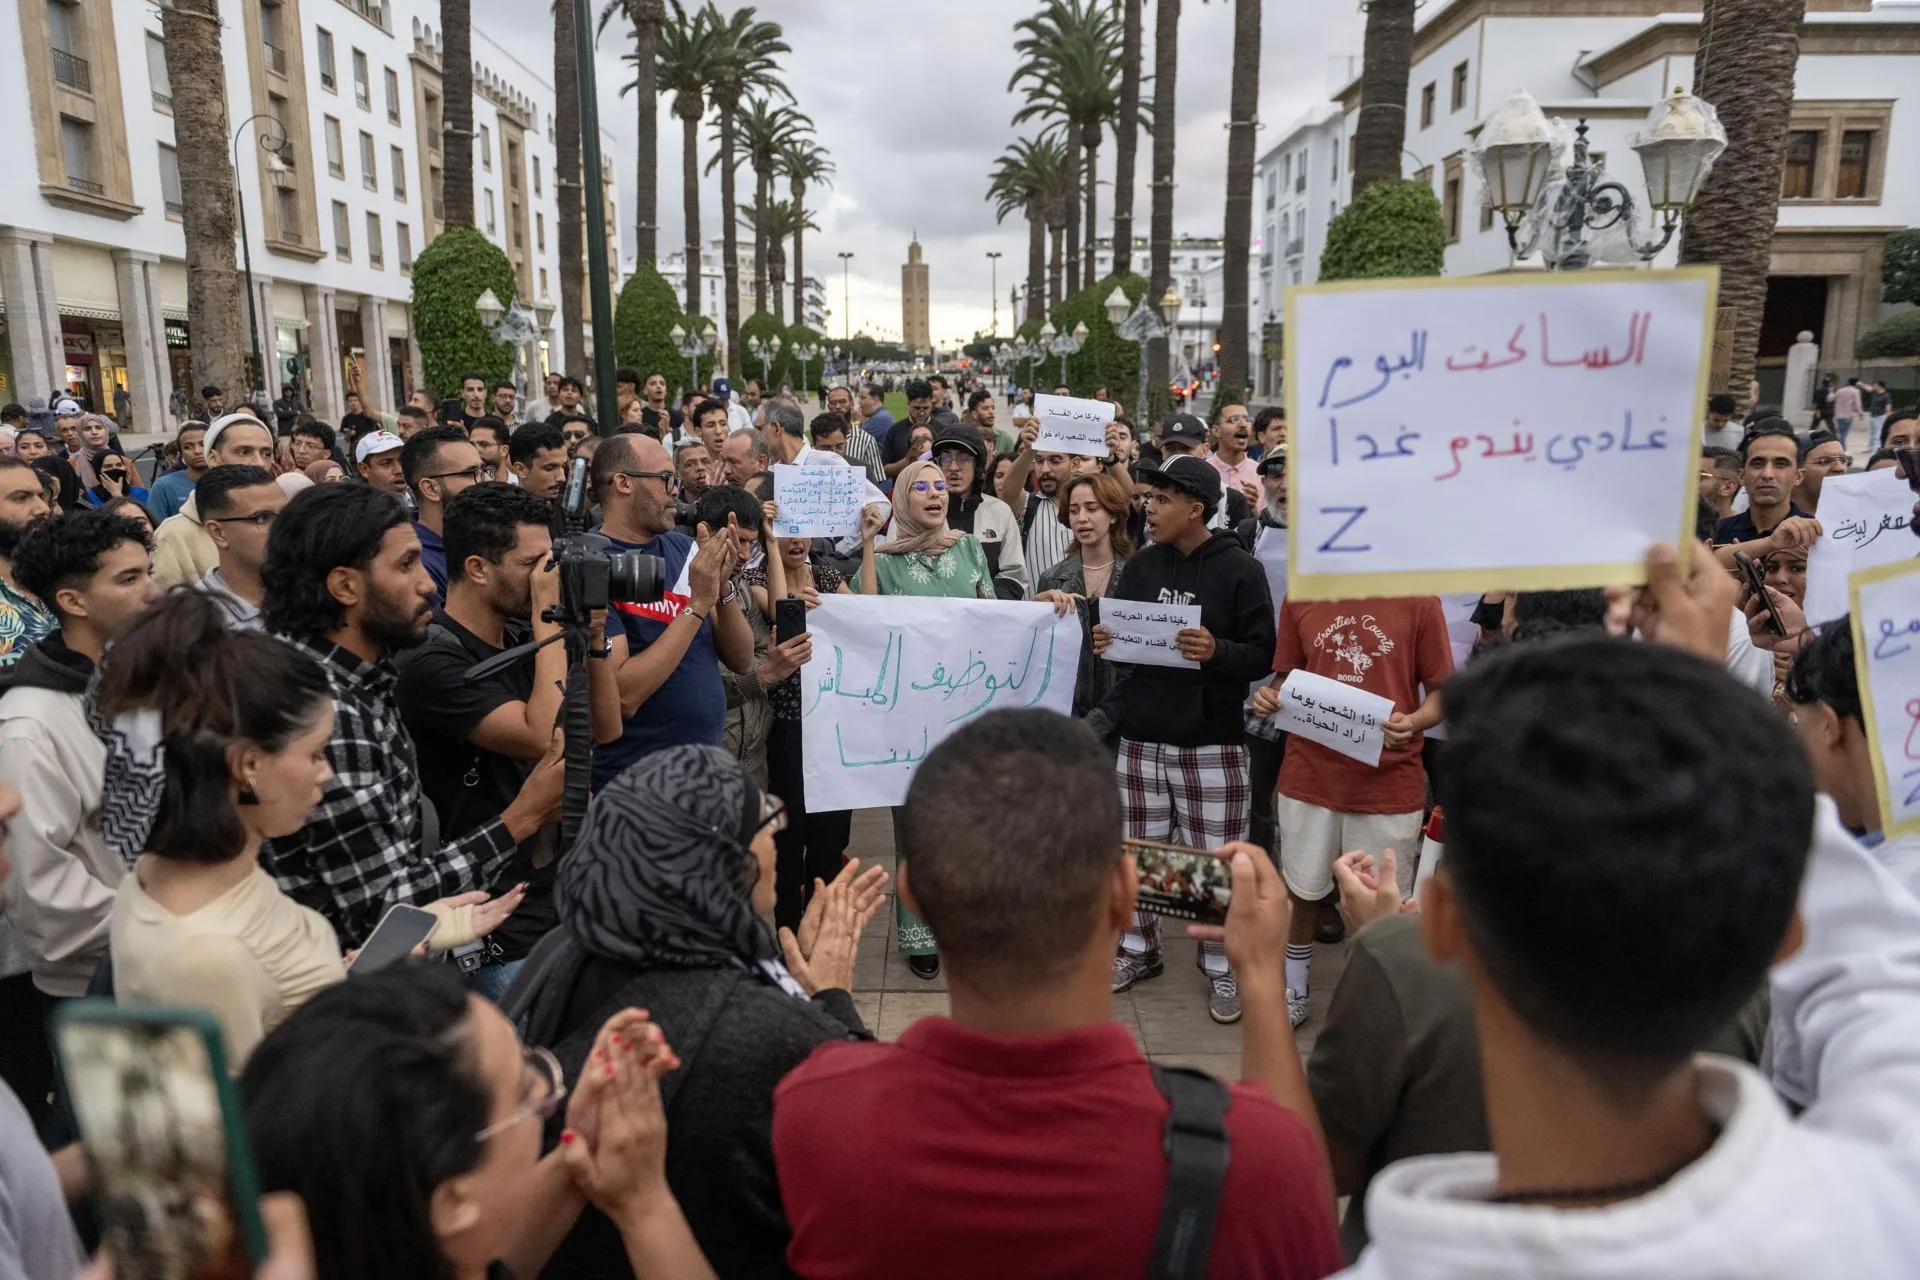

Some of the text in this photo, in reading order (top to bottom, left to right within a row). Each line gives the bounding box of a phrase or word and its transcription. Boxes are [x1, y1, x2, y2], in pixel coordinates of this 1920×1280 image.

[166, 327, 188, 337] OTEL
[1446, 310, 1652, 372] الساكت
[1316, 330, 1428, 410] اليوم
[1066, 433, 1087, 441] الشعب
[1329, 409, 1669, 482] غادي يندم غدا
[1316, 505, 1372, 553] Z
[1832, 513, 1911, 551] مغربية
[1112, 610, 1143, 621] الحريات
[1169, 614, 1188, 627] بغينا
[1313, 614, 1395, 655] Frontier County
[800, 624, 1056, 725] التوظيف المباشر
[1337, 673, 1364, 684] RODEO
[1291, 687, 1376, 730] إذا الشعب يوما
